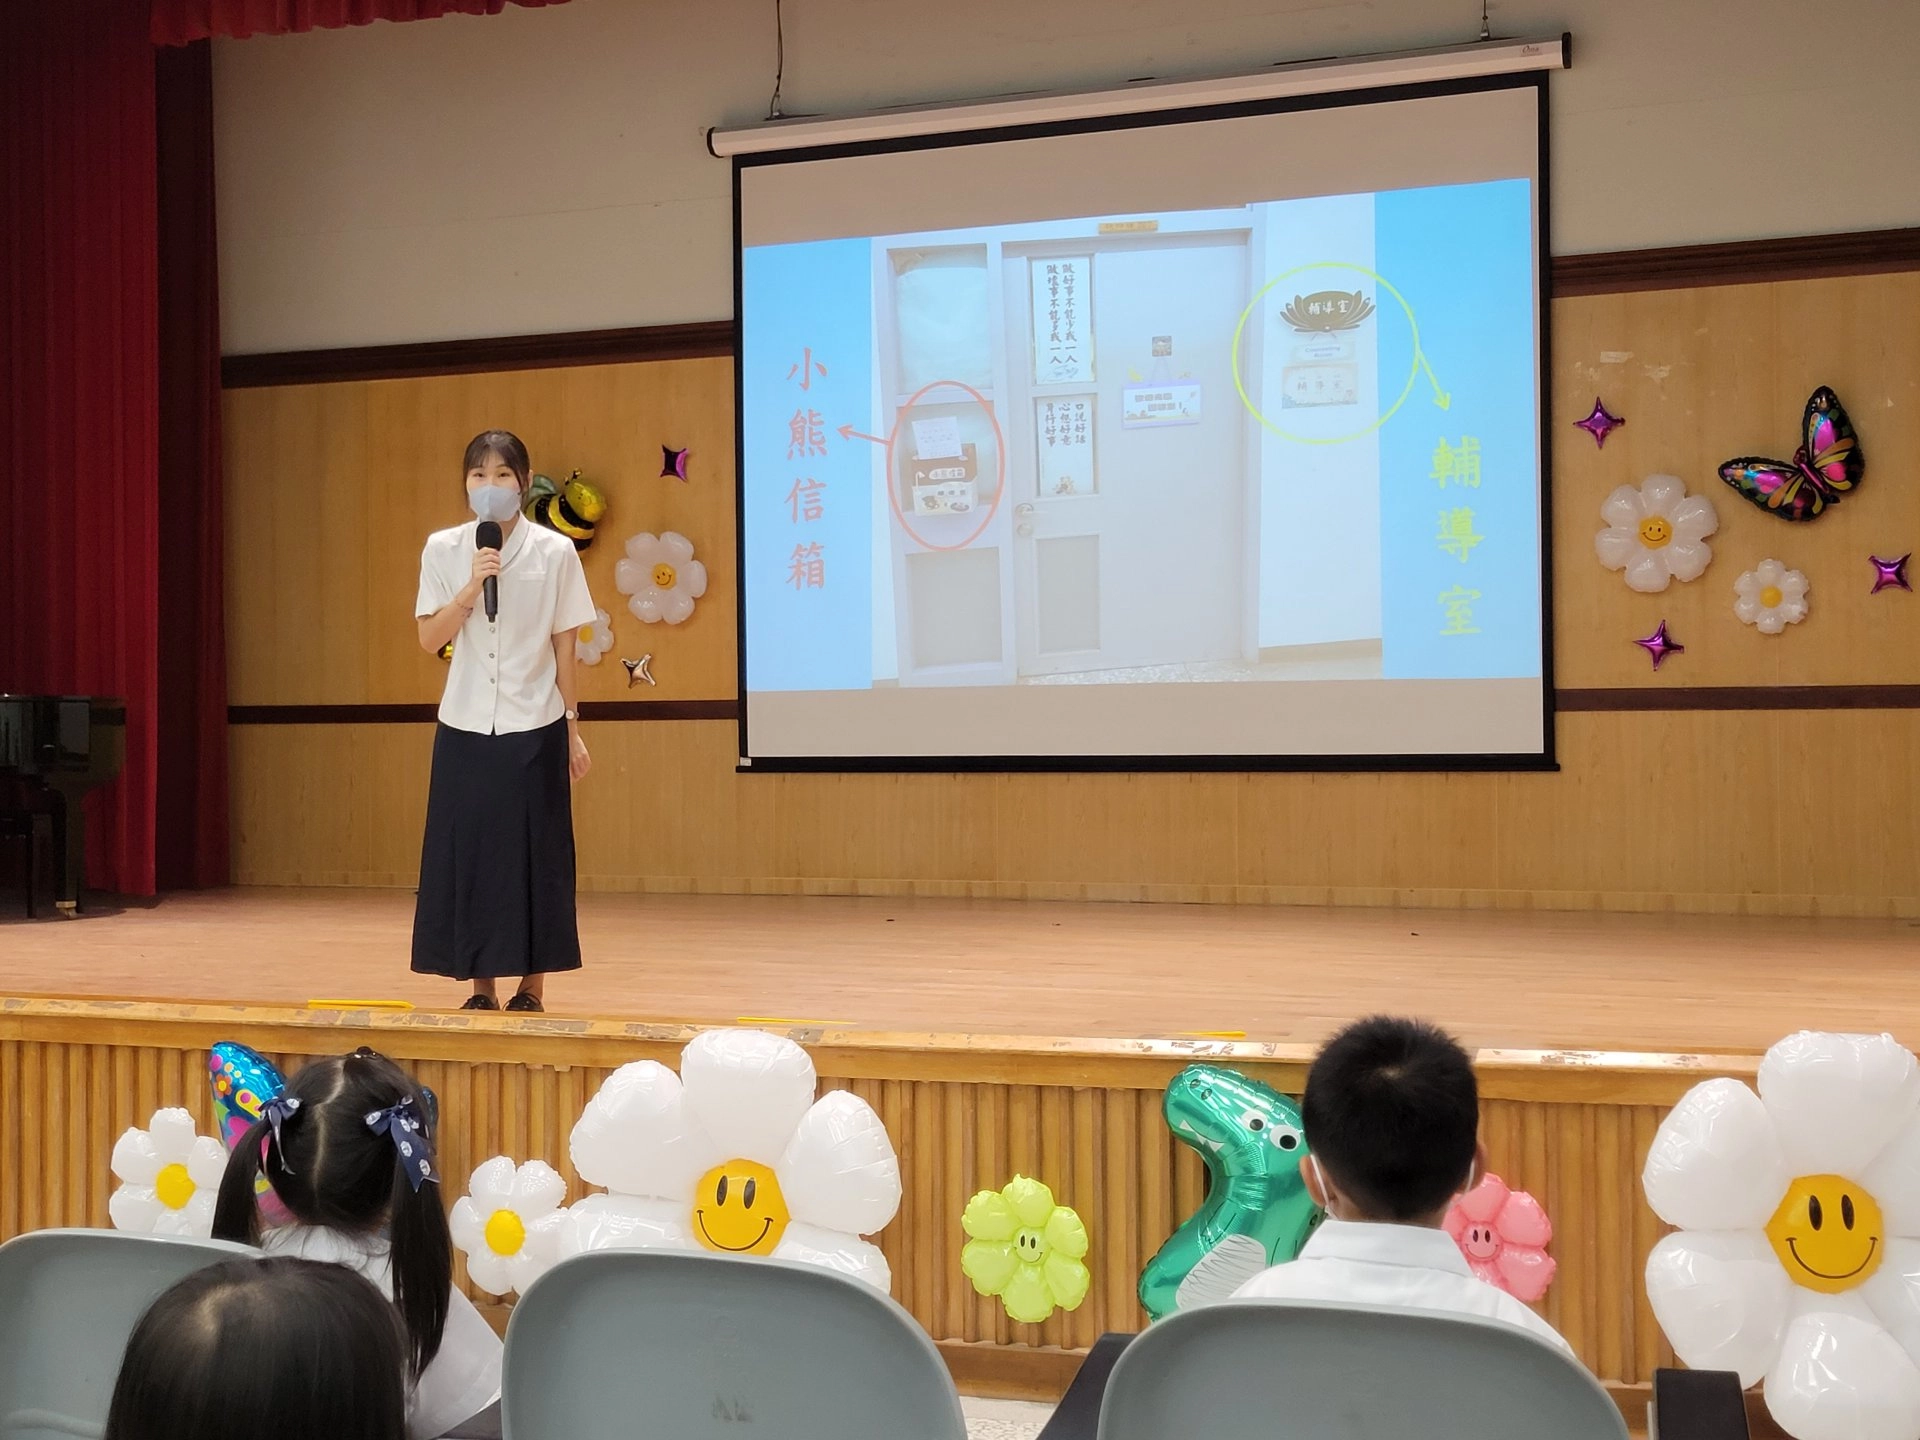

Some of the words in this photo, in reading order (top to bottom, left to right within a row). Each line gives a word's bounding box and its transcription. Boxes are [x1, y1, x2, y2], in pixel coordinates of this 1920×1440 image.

[784, 347, 828, 591] 小熊信箱
[1429, 435, 1486, 636] 輔導室
